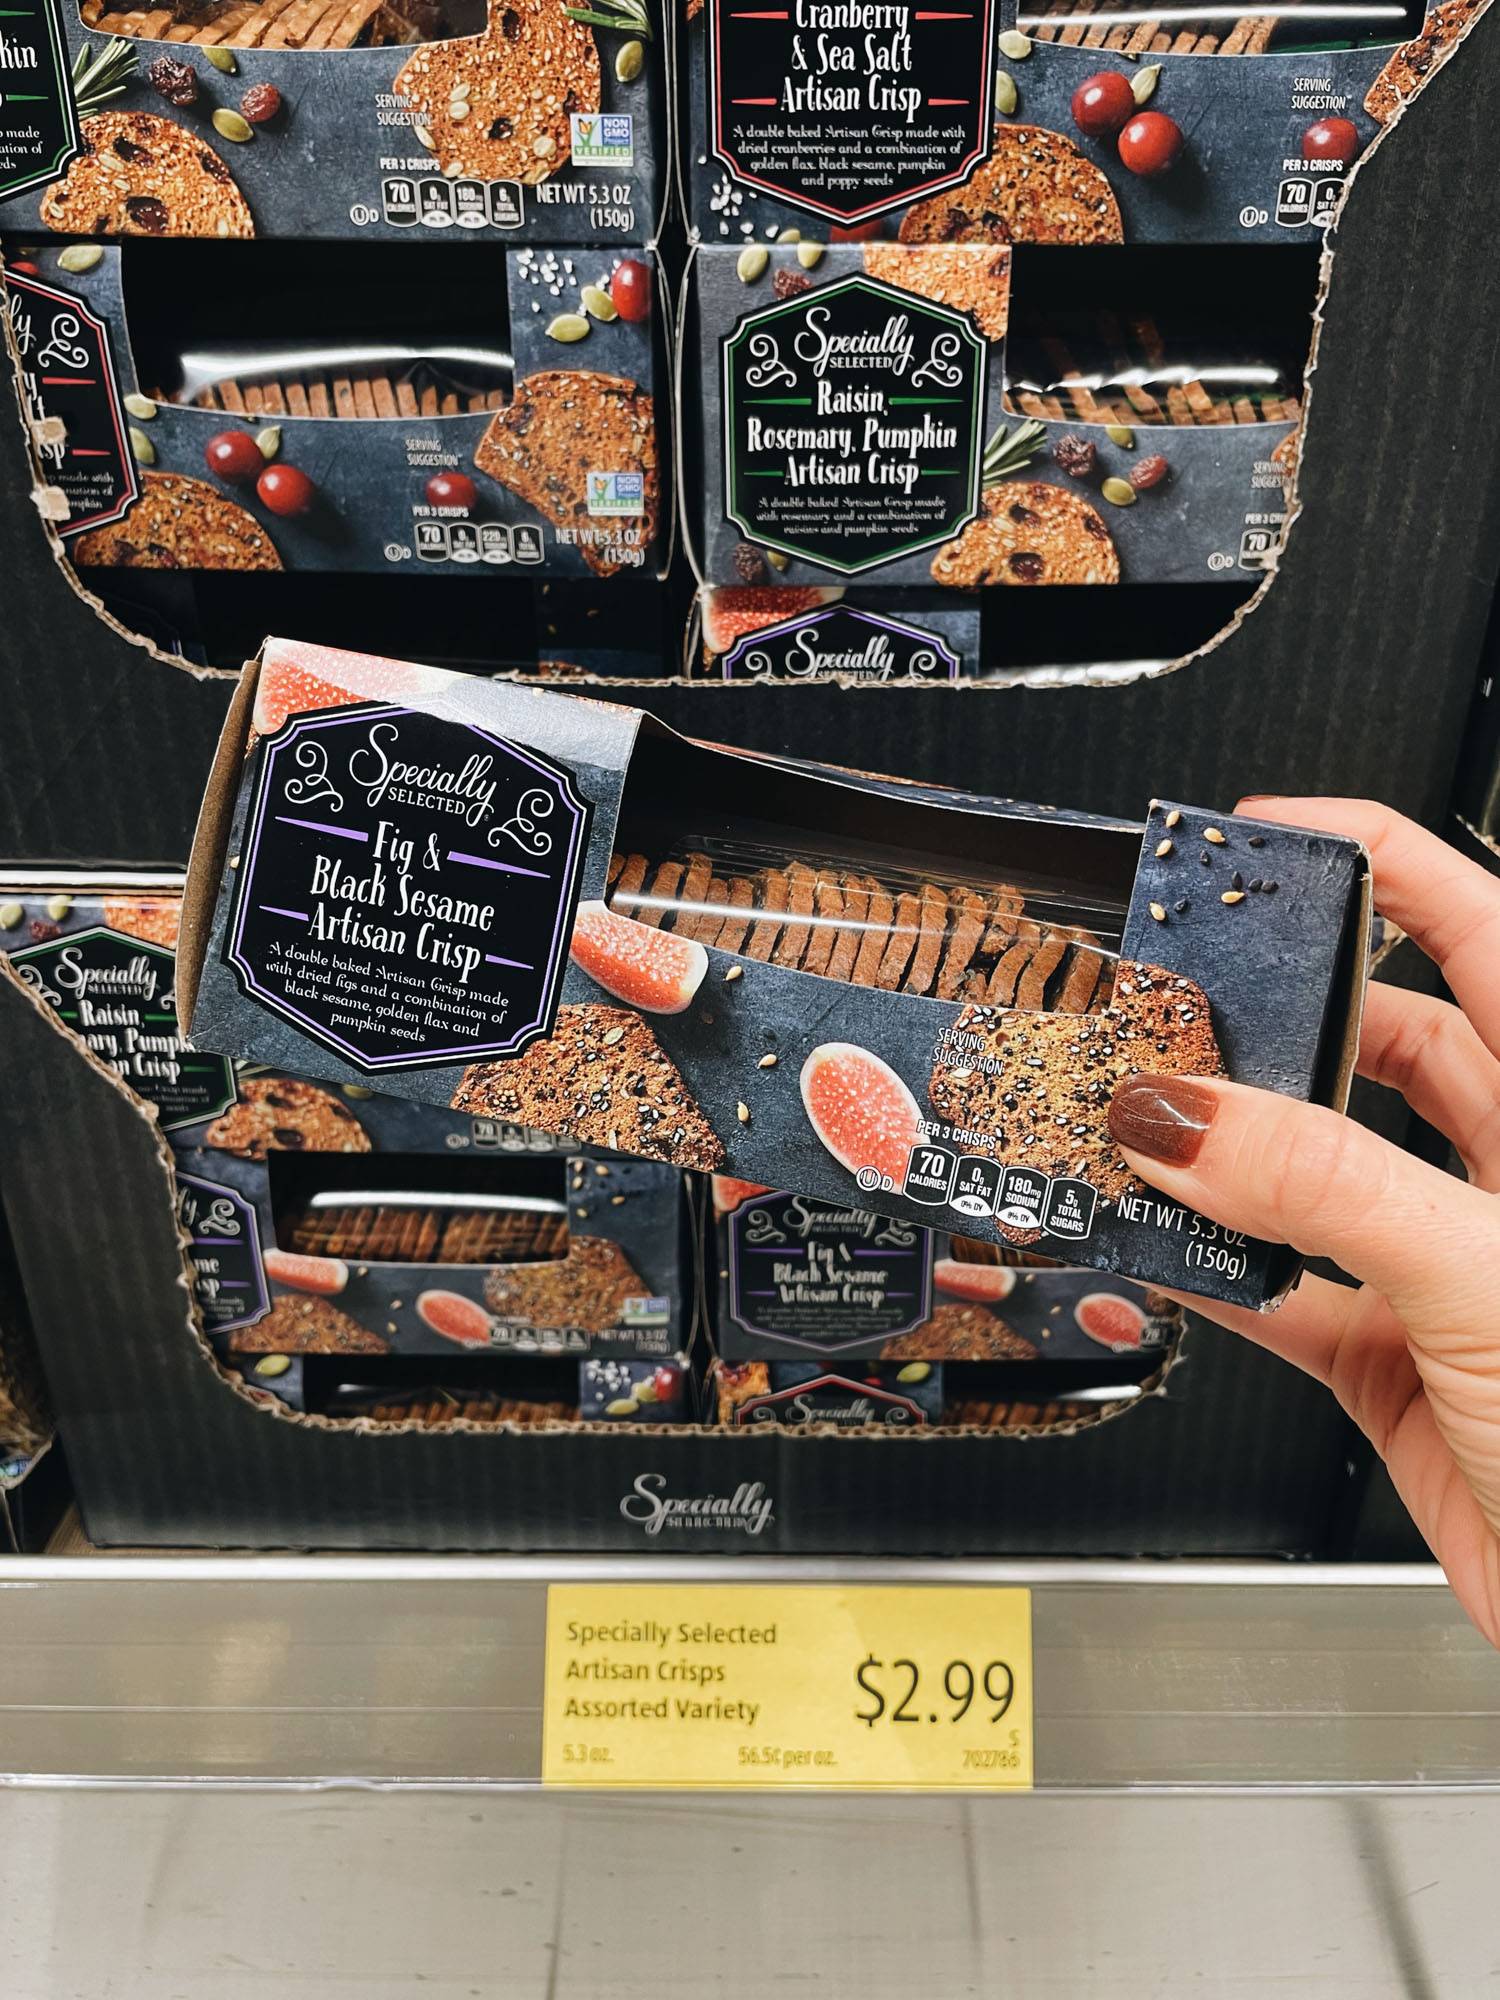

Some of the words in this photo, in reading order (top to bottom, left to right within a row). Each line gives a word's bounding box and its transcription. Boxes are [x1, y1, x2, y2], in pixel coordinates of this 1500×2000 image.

[796, 0, 908, 39] Cranberry
[792, 35, 808, 70] &
[817, 33, 856, 75] Sea
[863, 33, 912, 75] Salt
[1293, 78, 1331, 91] SERVING
[375, 94, 413, 108] SERVING
[781, 75, 860, 113] Artisan
[868, 74, 922, 123] Crisp
[1291, 95, 1346, 109] SUGGESTION
[377, 112, 432, 125] SUGGESTION
[603, 118, 629, 128] NON
[6, 126, 40, 138] made
[603, 128, 629, 138] GMO
[746, 124, 785, 138] double
[787, 124, 821, 138] baked
[825, 124, 868, 138] Artisan
[872, 124, 903, 142] Crisp
[905, 124, 939, 138] made
[942, 124, 966, 138] with
[31, 141, 43, 154] of
[738, 140, 768, 154] dried
[771, 140, 836, 154] cranberries
[838, 140, 861, 154] and
[864, 145, 872, 154] a
[875, 140, 946, 154] combination
[949, 140, 963, 154] of
[380, 158, 398, 170] PER
[400, 159, 406, 170] 3
[407, 158, 441, 171] CRISPS
[750, 156, 788, 173] golden
[819, 156, 849, 170] black
[898, 157, 946, 174] pumpkin
[1283, 159, 1301, 171] PER
[1302, 160, 1309, 171] 3
[1310, 159, 1344, 172] CRISPS
[801, 173, 824, 186] and
[828, 176, 859, 190] poppy
[863, 173, 894, 186] seeds
[389, 182, 410, 203] 70
[537, 184, 561, 204] NET
[563, 184, 586, 204] WT
[589, 184, 610, 205] 5.3
[612, 185, 632, 205] OZ
[1287, 184, 1307, 204] 70
[591, 207, 635, 232] (150g)
[794, 306, 915, 378] Specially
[829, 356, 893, 369] SELECTED
[817, 378, 889, 416] Raisin,
[405, 440, 442, 451] SERVING
[862, 412, 958, 459] Pumpkin
[407, 453, 459, 466] SUGGESTION
[784, 453, 861, 488] Artisan
[867, 452, 919, 495] Crisp
[421, 526, 441, 543] 70
[555, 528, 577, 544] NET
[580, 528, 600, 545] WT
[1248, 534, 1267, 550] 70
[785, 628, 895, 681] Specially
[350, 723, 497, 827] Specially
[388, 786, 466, 816] SELECTED
[372, 821, 414, 875] Fig
[423, 833, 442, 872] &
[310, 855, 386, 907] Black
[393, 874, 496, 932] Sesame
[308, 902, 405, 955] Artisan
[416, 922, 481, 984] Crisp
[55, 947, 157, 1000] Specially
[269, 941, 281, 956] A
[285, 944, 329, 966] double
[332, 954, 371, 976] baked
[375, 965, 425, 989] Artisan
[430, 976, 466, 1001] Crisp
[470, 991, 509, 1007] made
[266, 961, 293, 976] with
[297, 965, 331, 985] dried
[335, 973, 358, 994] figs
[361, 983, 387, 998] and
[391, 992, 400, 1000] a
[404, 995, 486, 1021] combination
[491, 1010, 508, 1025] of
[78, 1000, 145, 1028] Raisin,
[285, 979, 319, 1000] black
[375, 1003, 420, 1024] golden
[424, 1011, 449, 1030] flax
[452, 1023, 480, 1037] and
[330, 1013, 386, 1034] pumpkin
[390, 1027, 426, 1042] seeds
[936, 1027, 986, 1052] SERVING
[133, 1052, 181, 1085] Crisp
[932, 1046, 1004, 1076] SUGGESTION
[916, 1120, 940, 1138] PER
[942, 1126, 950, 1140] 3
[951, 1127, 997, 1150] CRISPS
[920, 1151, 946, 1178] 70
[908, 1172, 948, 1192] CALORIES
[971, 1167, 985, 1185] 0g
[1008, 1176, 1042, 1197] 180mg
[958, 1180, 975, 1194] SAT
[976, 1184, 992, 1198] FAT
[1065, 1189, 1079, 1208] 5g
[1004, 1193, 1040, 1209] SODIUM
[1057, 1204, 1082, 1219] TOTAL
[1050, 1216, 1085, 1233] SUGARS
[1117, 1195, 1154, 1224] NET
[1156, 1203, 1187, 1232] WT
[1188, 1214, 1219, 1240] 5.3
[1185, 1240, 1248, 1281] (150g)
[619, 1473, 775, 1536] Specially
[567, 1620, 671, 1648] Specially
[678, 1622, 777, 1644] Selected
[566, 1657, 649, 1680] Artisan
[657, 1659, 726, 1687] Crisps
[854, 1653, 1016, 1728] $2.99
[565, 1697, 669, 1719] Assorted
[675, 1697, 759, 1725] Variety
[562, 1743, 588, 1763] 5.3
[783, 1748, 810, 1769] per
